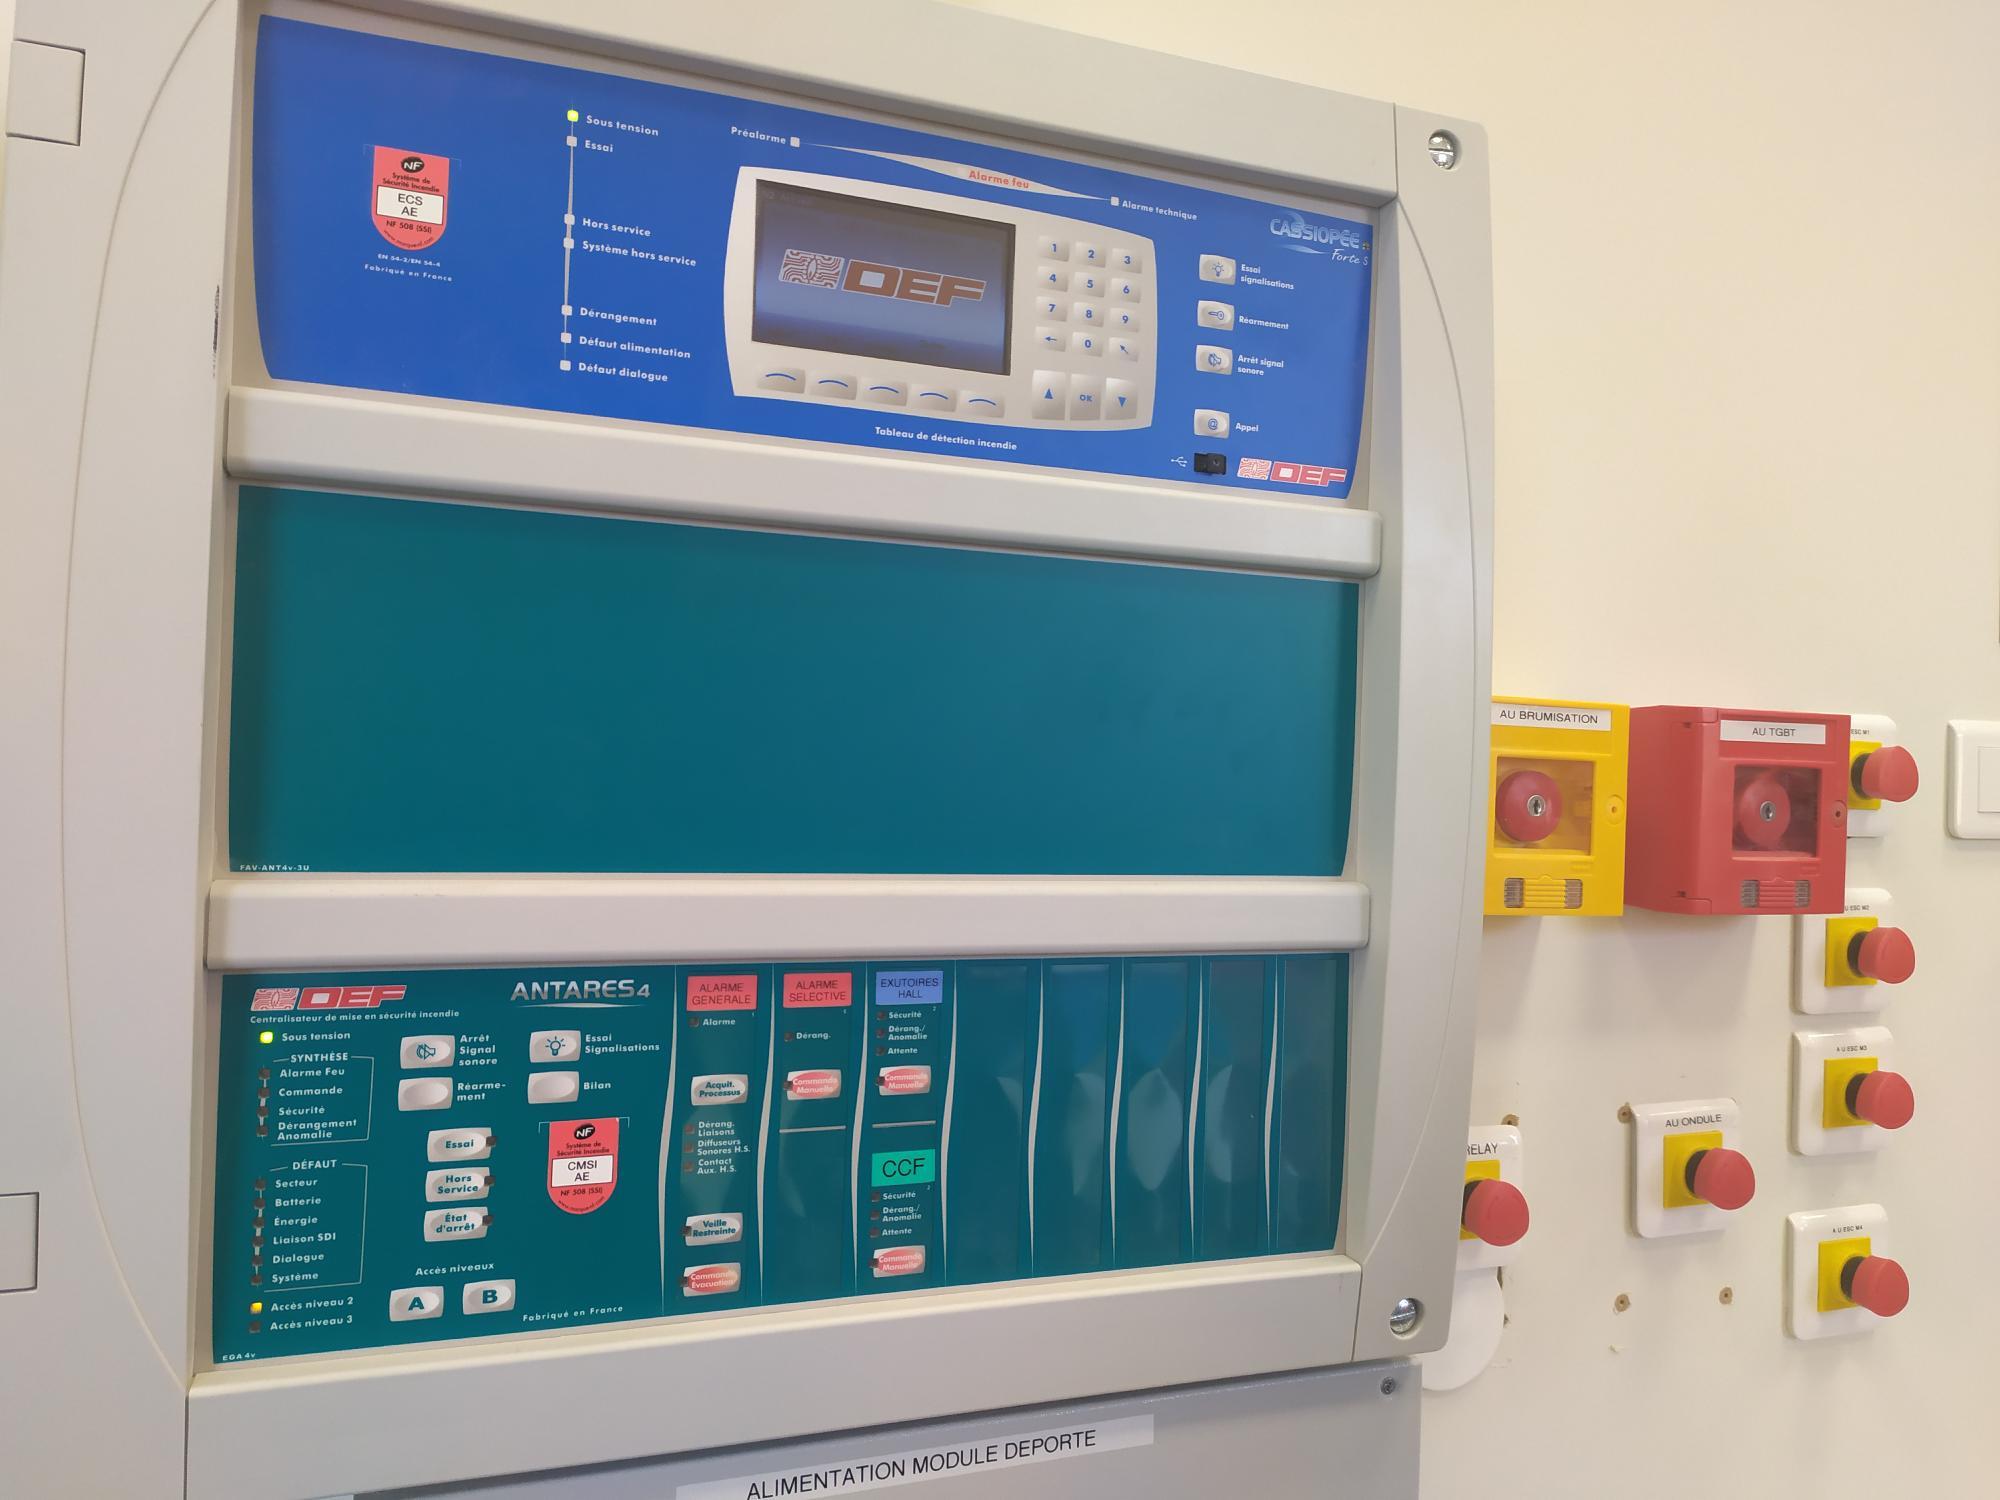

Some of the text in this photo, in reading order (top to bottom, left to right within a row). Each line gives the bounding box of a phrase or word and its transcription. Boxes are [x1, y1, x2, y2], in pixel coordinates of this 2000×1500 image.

[586, 115, 659, 136] Sous tension
[730, 126, 787, 145] Préalarme
[585, 140, 614, 153] Essai
[404, 161, 422, 170] NF
[969, 169, 1030, 189] Alarme feu
[398, 193, 423, 206] ECS
[401, 206, 418, 217] AE
[1122, 200, 1198, 222] Alarme technique
[582, 217, 651, 237] Hors service
[582, 240, 697, 267] Système hors service
[1052, 243, 1131, 265] 1 2 3
[1331, 249, 1369, 266] Forte S
[1241, 263, 1261, 274] Essai
[423, 272, 452, 282] France
[1240, 275, 1295, 290] signalisations
[841, 259, 987, 307] DEF
[1049, 274, 1130, 294] 4 5 6
[580, 307, 657, 326] Dérangement
[1049, 304, 1129, 324] 7 8 9
[1238, 315, 1289, 330] Réarmement
[579, 336, 691, 359] Défaut alimentation
[1084, 339, 1092, 348] 0
[1237, 354, 1285, 369] Arrêt signal
[578, 362, 668, 382] Défaut dialogue
[1237, 367, 1265, 377] sonore
[1079, 394, 1093, 402] OK
[1235, 422, 1259, 433] Appel
[875, 426, 1017, 451] Tableau de détection incendie
[1270, 461, 1347, 487] DEF
[1499, 709, 1598, 725] AU BRUMISATION
[1751, 726, 1796, 738] AU TGBT
[699, 983, 744, 993] ALARME
[795, 980, 839, 990] ALARME
[880, 978, 939, 988] EXUTOIRES
[297, 984, 407, 1010] DEF
[692, 994, 751, 1006] GENERALE
[789, 991, 846, 1002] SELECTIVE
[898, 990, 923, 999] HALL
[250, 1014, 322, 1024] Centralisateur
[324, 1013, 338, 1021] de
[340, 1013, 362, 1021] mise
[379, 1010, 417, 1020] sécurité
[419, 1009, 460, 1019] incendie
[888, 1011, 922, 1019] Sécurité
[702, 1018, 736, 1026] Alarme
[281, 1032, 351, 1042] Sous tension
[459, 1034, 490, 1043] Arrêt
[585, 1033, 612, 1042] Essai
[796, 1032, 831, 1040] Dérang.
[888, 1033, 928, 1041] Anomalie
[459, 1045, 496, 1056] Signal
[585, 1044, 660, 1054] Signalisations
[887, 1047, 918, 1055] Attente
[290, 1052, 349, 1063] SYNTHÈSE
[459, 1058, 498, 1066] sonore
[280, 1068, 345, 1078] Alarme Feu
[278, 1086, 343, 1097] Commande
[457, 1082, 506, 1091] Réarme-
[583, 1082, 612, 1090] Bilan
[796, 1085, 834, 1094] Manuelle
[456, 1092, 486, 1101] ment
[699, 1089, 741, 1098] Processus
[278, 1105, 325, 1116] Sécurité
[278, 1119, 357, 1132] Dérangement
[1666, 1114, 1722, 1128] AU ONDULE
[277, 1130, 332, 1141] Anomalie
[576, 1127, 594, 1138] NF
[698, 1128, 735, 1137] Liaisons
[445, 1139, 474, 1149] Essai
[697, 1138, 741, 1148] Diffuseurs
[697, 1145, 751, 1156] Sonores H.S.
[292, 1159, 337, 1171] DÉFAUT
[567, 1160, 598, 1171] CMSI
[698, 1158, 732, 1167] Contact
[882, 1158, 925, 1178] CCF
[697, 1165, 737, 1175] Aux. H.S.
[445, 1174, 472, 1184] Hors
[574, 1172, 590, 1182] AE
[275, 1178, 318, 1188] Secteur
[437, 1183, 479, 1195] Service
[882, 1191, 916, 1200] Sécurité
[275, 1196, 321, 1207] Batterie
[274, 1215, 318, 1227] Énergie
[445, 1213, 468, 1223] État
[702, 1219, 727, 1228] Veille
[882, 1213, 922, 1223] Anomalie
[435, 1222, 475, 1234] d'arrêt
[692, 1227, 736, 1238] Restreinte
[881, 1228, 913, 1236] Attente
[273, 1233, 336, 1245] Liaison SDI
[272, 1252, 325, 1264] Dialogue
[415, 1262, 495, 1277] Accès niveaux
[271, 1271, 319, 1284] Système
[270, 1297, 354, 1312] Accès niveau 2
[408, 1289, 498, 1311] A B
[522, 1310, 569, 1322] Fabriqué
[589, 1305, 624, 1315] France
[270, 1315, 353, 1331] Accès niveau 3
[222, 1353, 243, 1361] EGA
[747, 1429, 1097, 1500] ALIMENTATION MODULE DEPORTE
